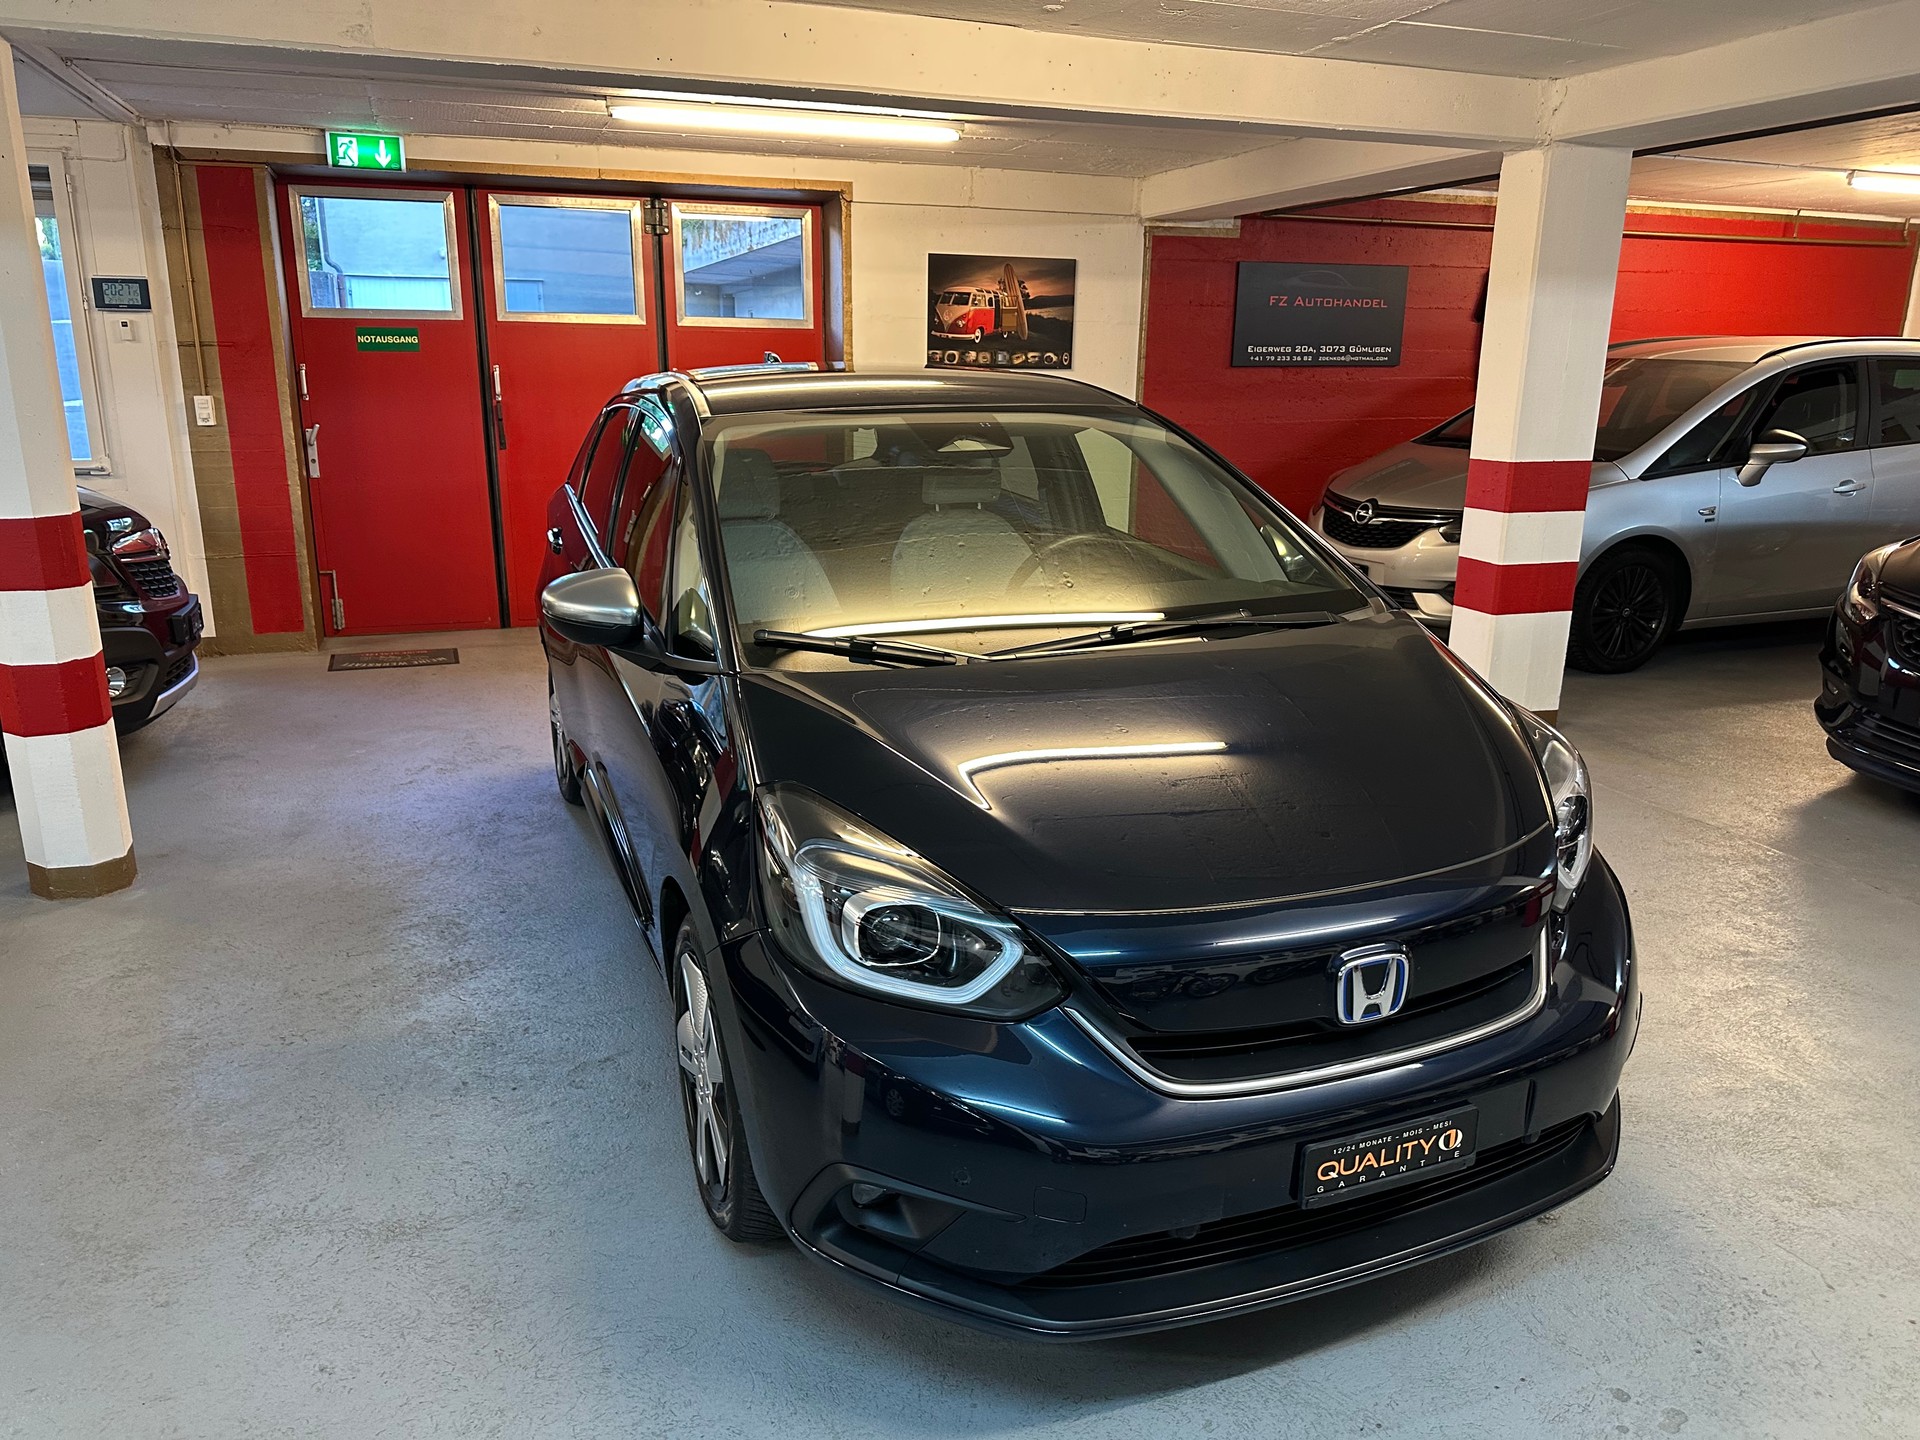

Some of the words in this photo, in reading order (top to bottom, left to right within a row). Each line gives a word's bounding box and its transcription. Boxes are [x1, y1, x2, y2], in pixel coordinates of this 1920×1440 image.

[1269, 295, 1289, 307] FZ
[357, 335, 419, 344] NOTAUSGANG
[1319, 345, 1346, 353] 3073
[1333, 1144, 1356, 1155] 12/24
[1359, 1135, 1393, 1149] MONATE
[1402, 1127, 1423, 1138] MOIS
[1433, 1119, 1452, 1130] MESI
[1316, 1150, 1461, 1193] GARANTIE
